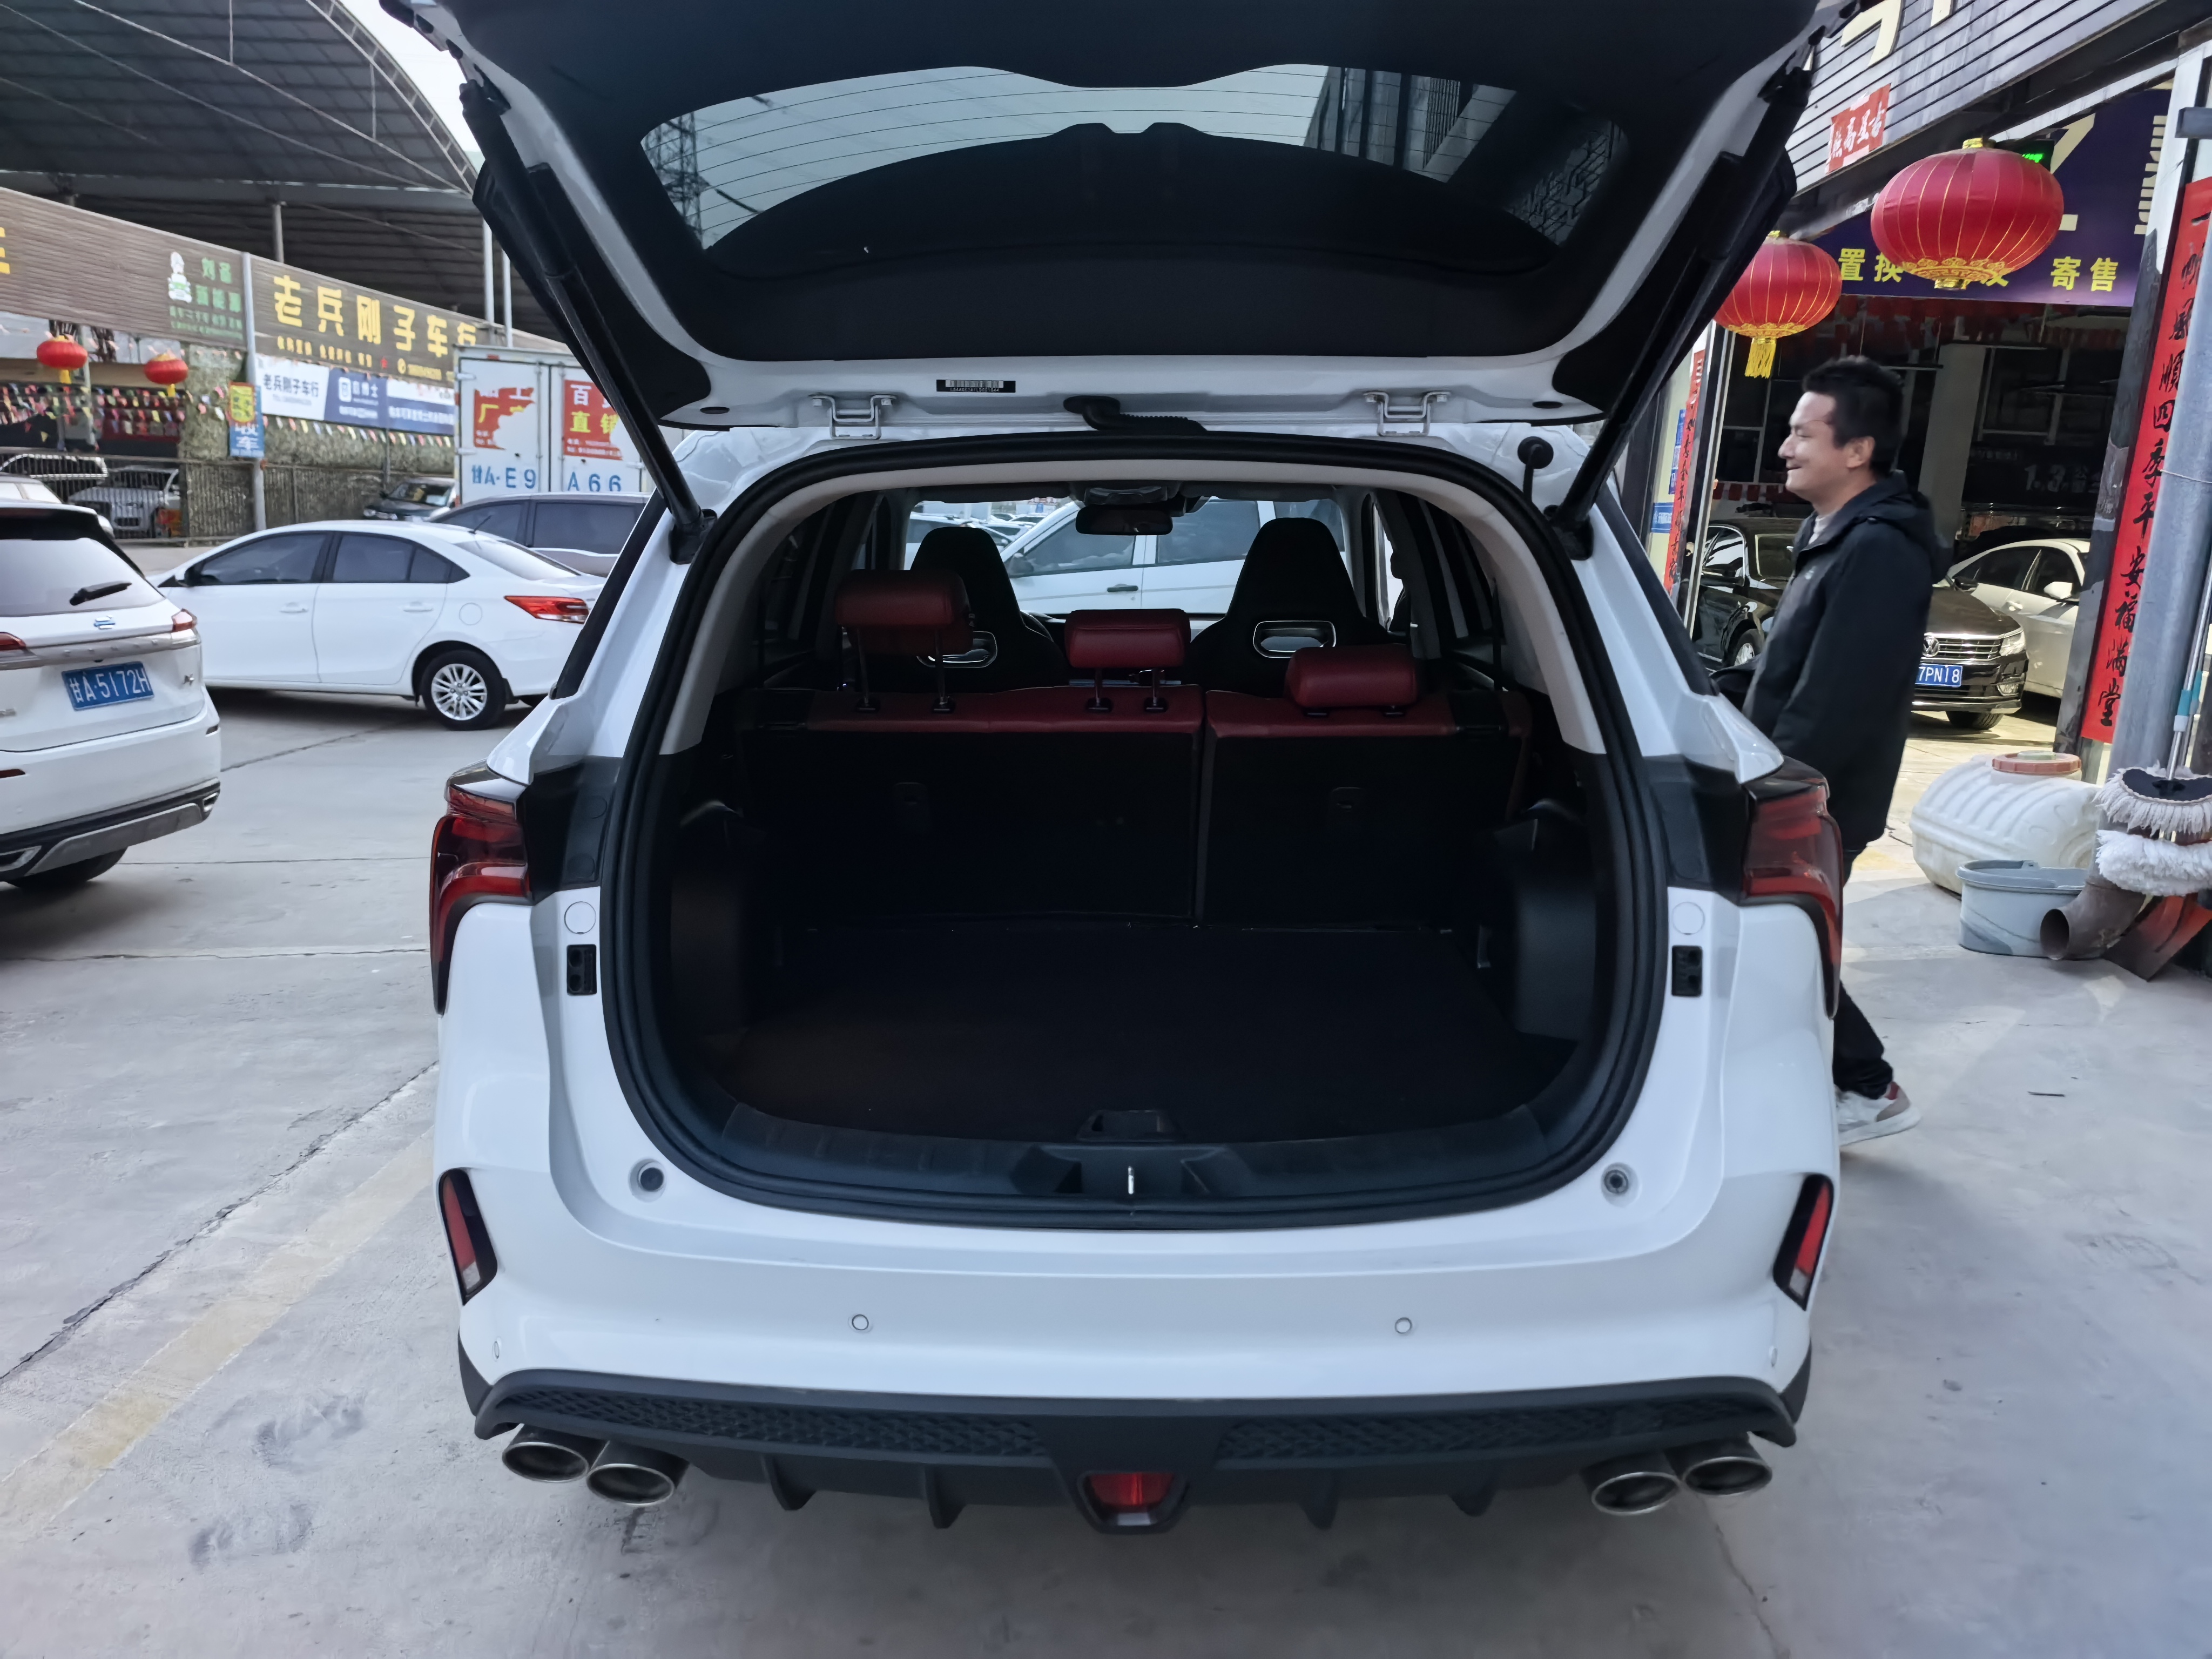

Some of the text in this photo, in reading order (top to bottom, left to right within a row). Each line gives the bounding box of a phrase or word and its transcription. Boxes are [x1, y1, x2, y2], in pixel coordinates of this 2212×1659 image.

[1838, 248, 1904, 282] 置换
[2051, 256, 2119, 292] 寄售
[274, 275, 477, 358] 老兵刚子车行
